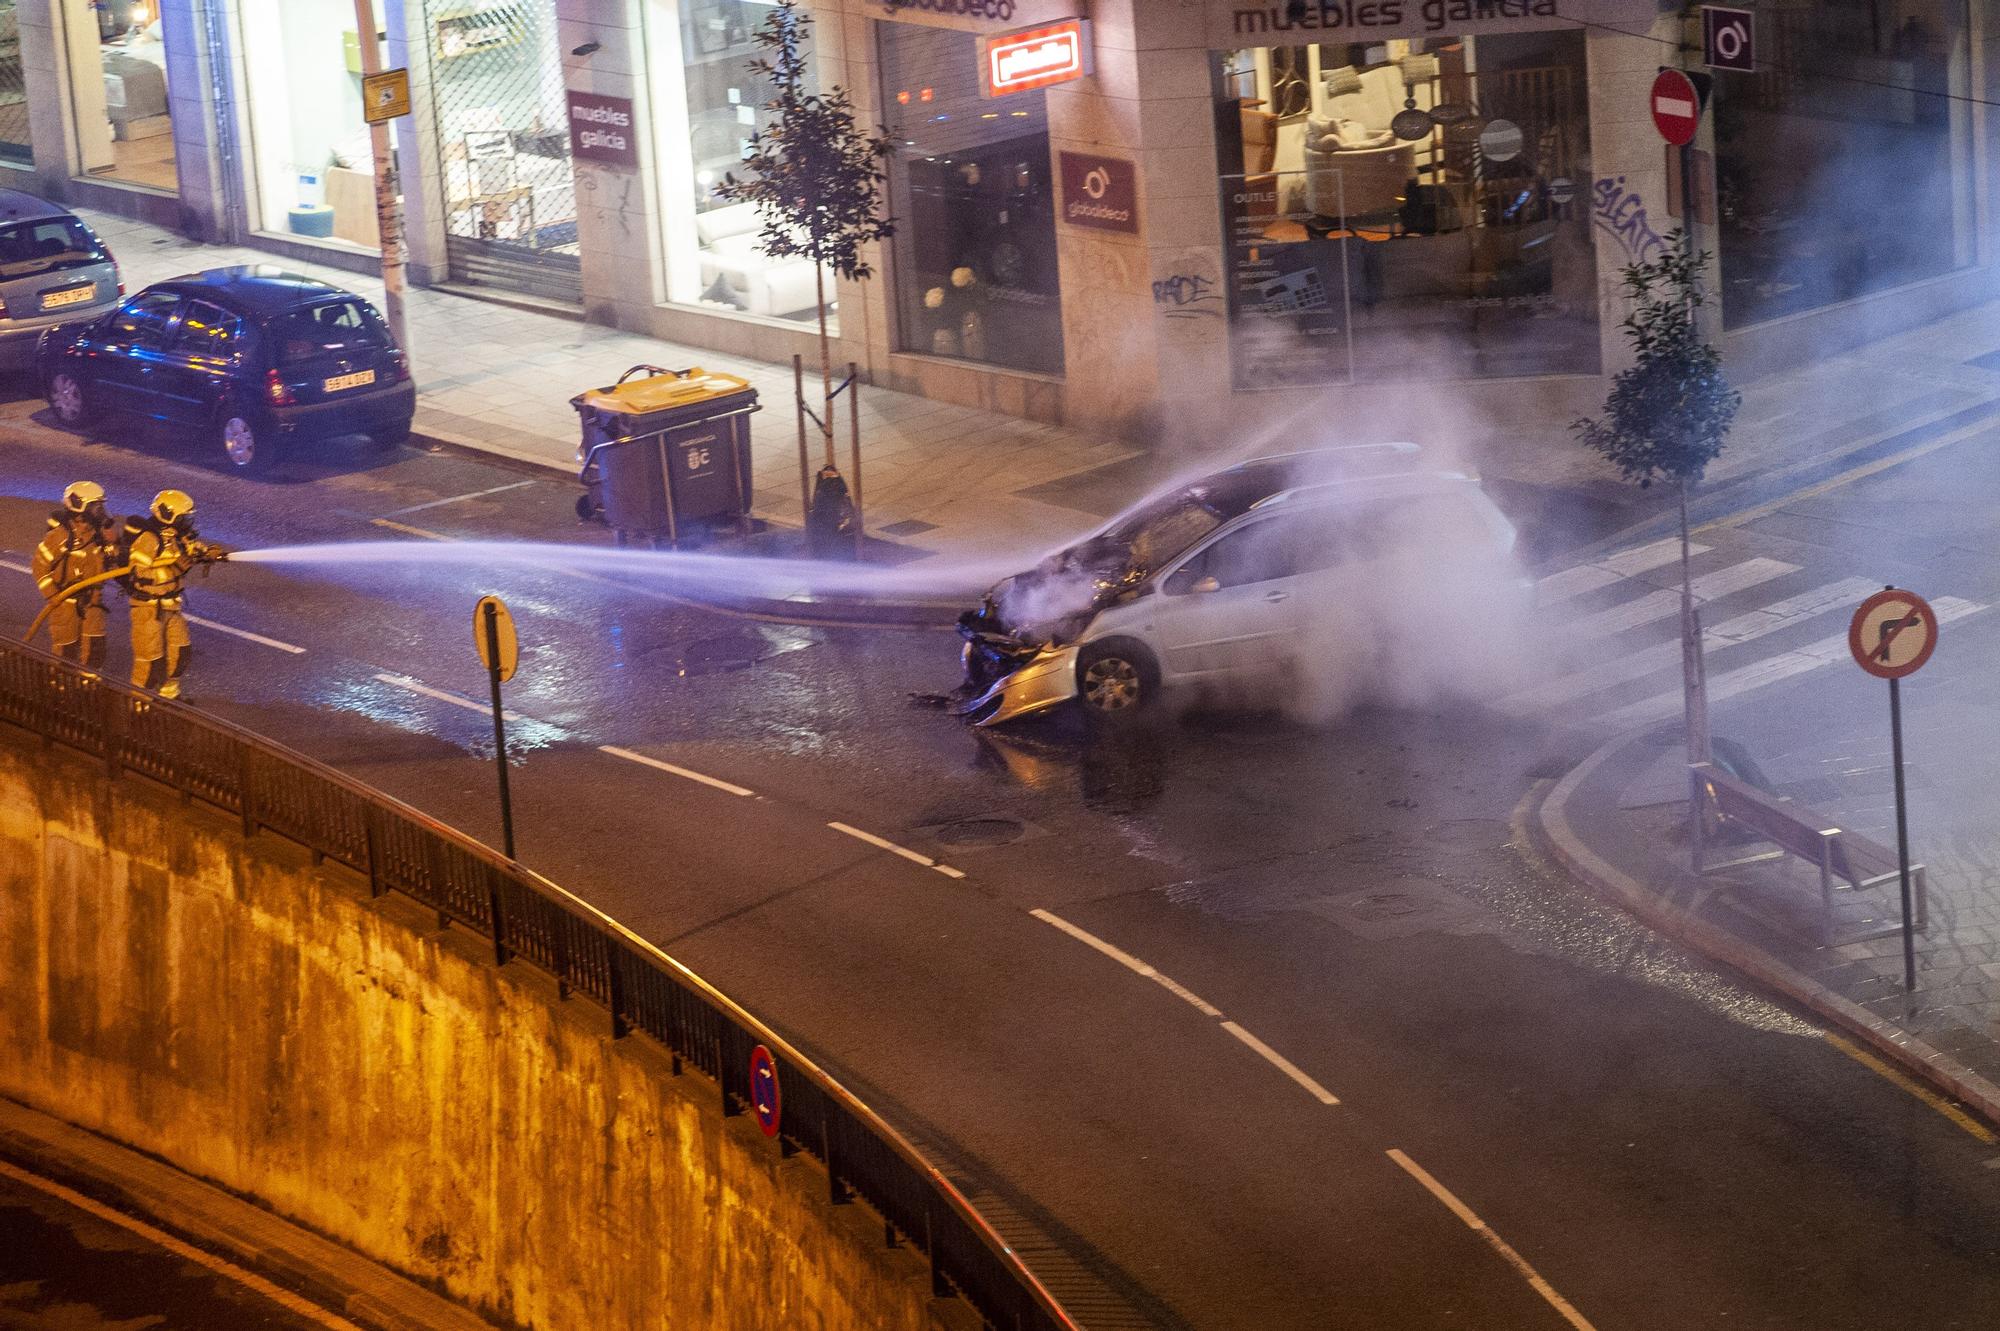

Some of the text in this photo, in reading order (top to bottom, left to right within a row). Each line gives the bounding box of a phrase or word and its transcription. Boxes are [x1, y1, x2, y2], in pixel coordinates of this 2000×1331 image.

[1233, 0, 1403, 33] muebles
[571, 105, 630, 127] muebles
[579, 129, 627, 151] galicia
[1233, 191, 1283, 204] OUTLE
